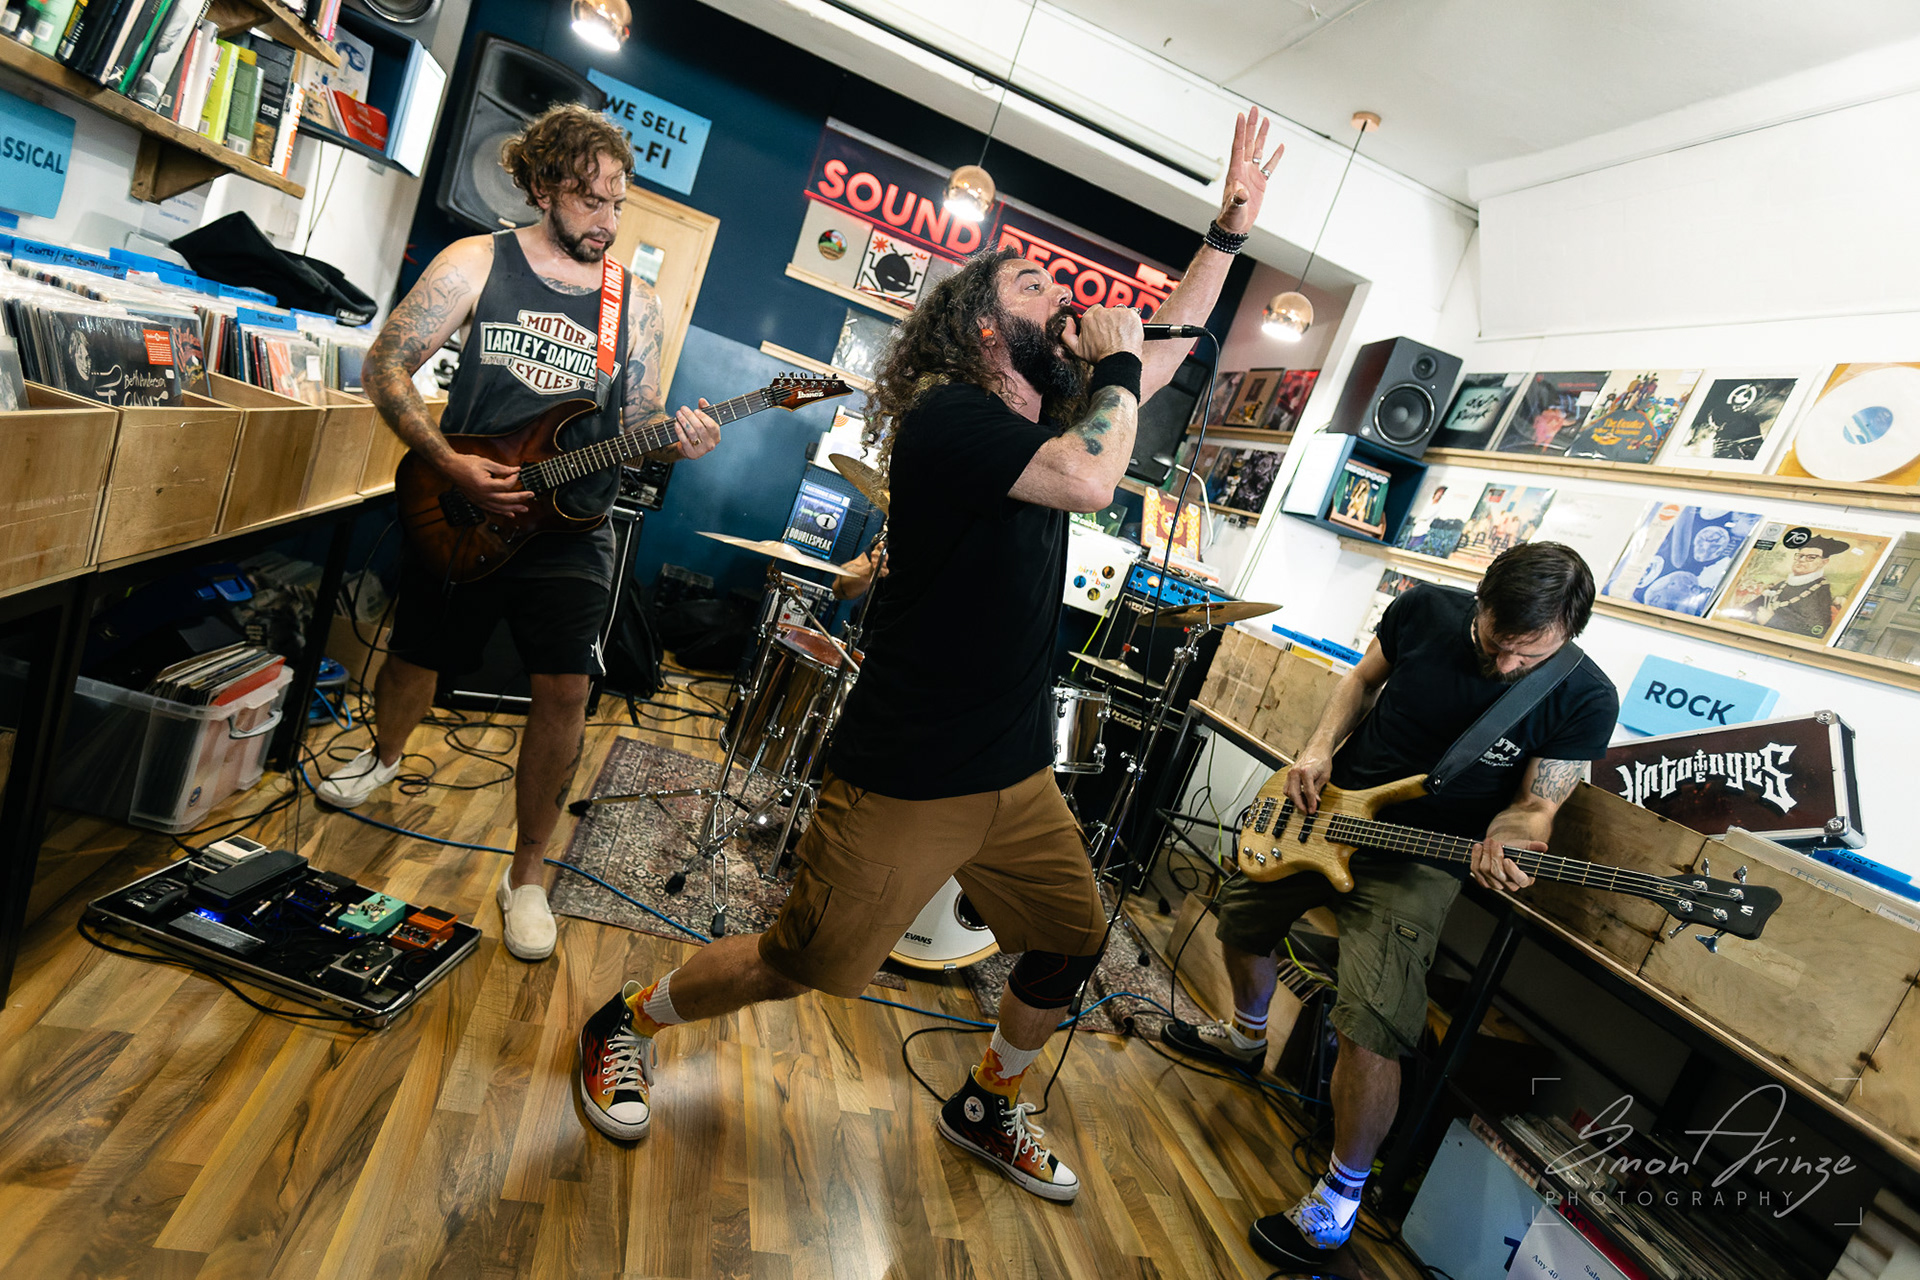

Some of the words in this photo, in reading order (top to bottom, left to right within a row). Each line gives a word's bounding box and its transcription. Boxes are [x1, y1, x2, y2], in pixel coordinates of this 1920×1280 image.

[605, 96, 637, 121] WE
[641, 110, 688, 144] SELL
[0, 136, 64, 175] SSICAL
[818, 159, 982, 254] SOUND
[526, 315, 587, 346] MOTOR
[600, 298, 619, 352] TRICKS!
[516, 363, 573, 390] CYCLES
[797, 390, 824, 399] Ibanez
[788, 527, 833, 551] DOUBLESPEAK
[1645, 681, 1735, 726] ROCK
[904, 932, 933, 945] EVANS
[1531, 1254, 1548, 1271] Any
